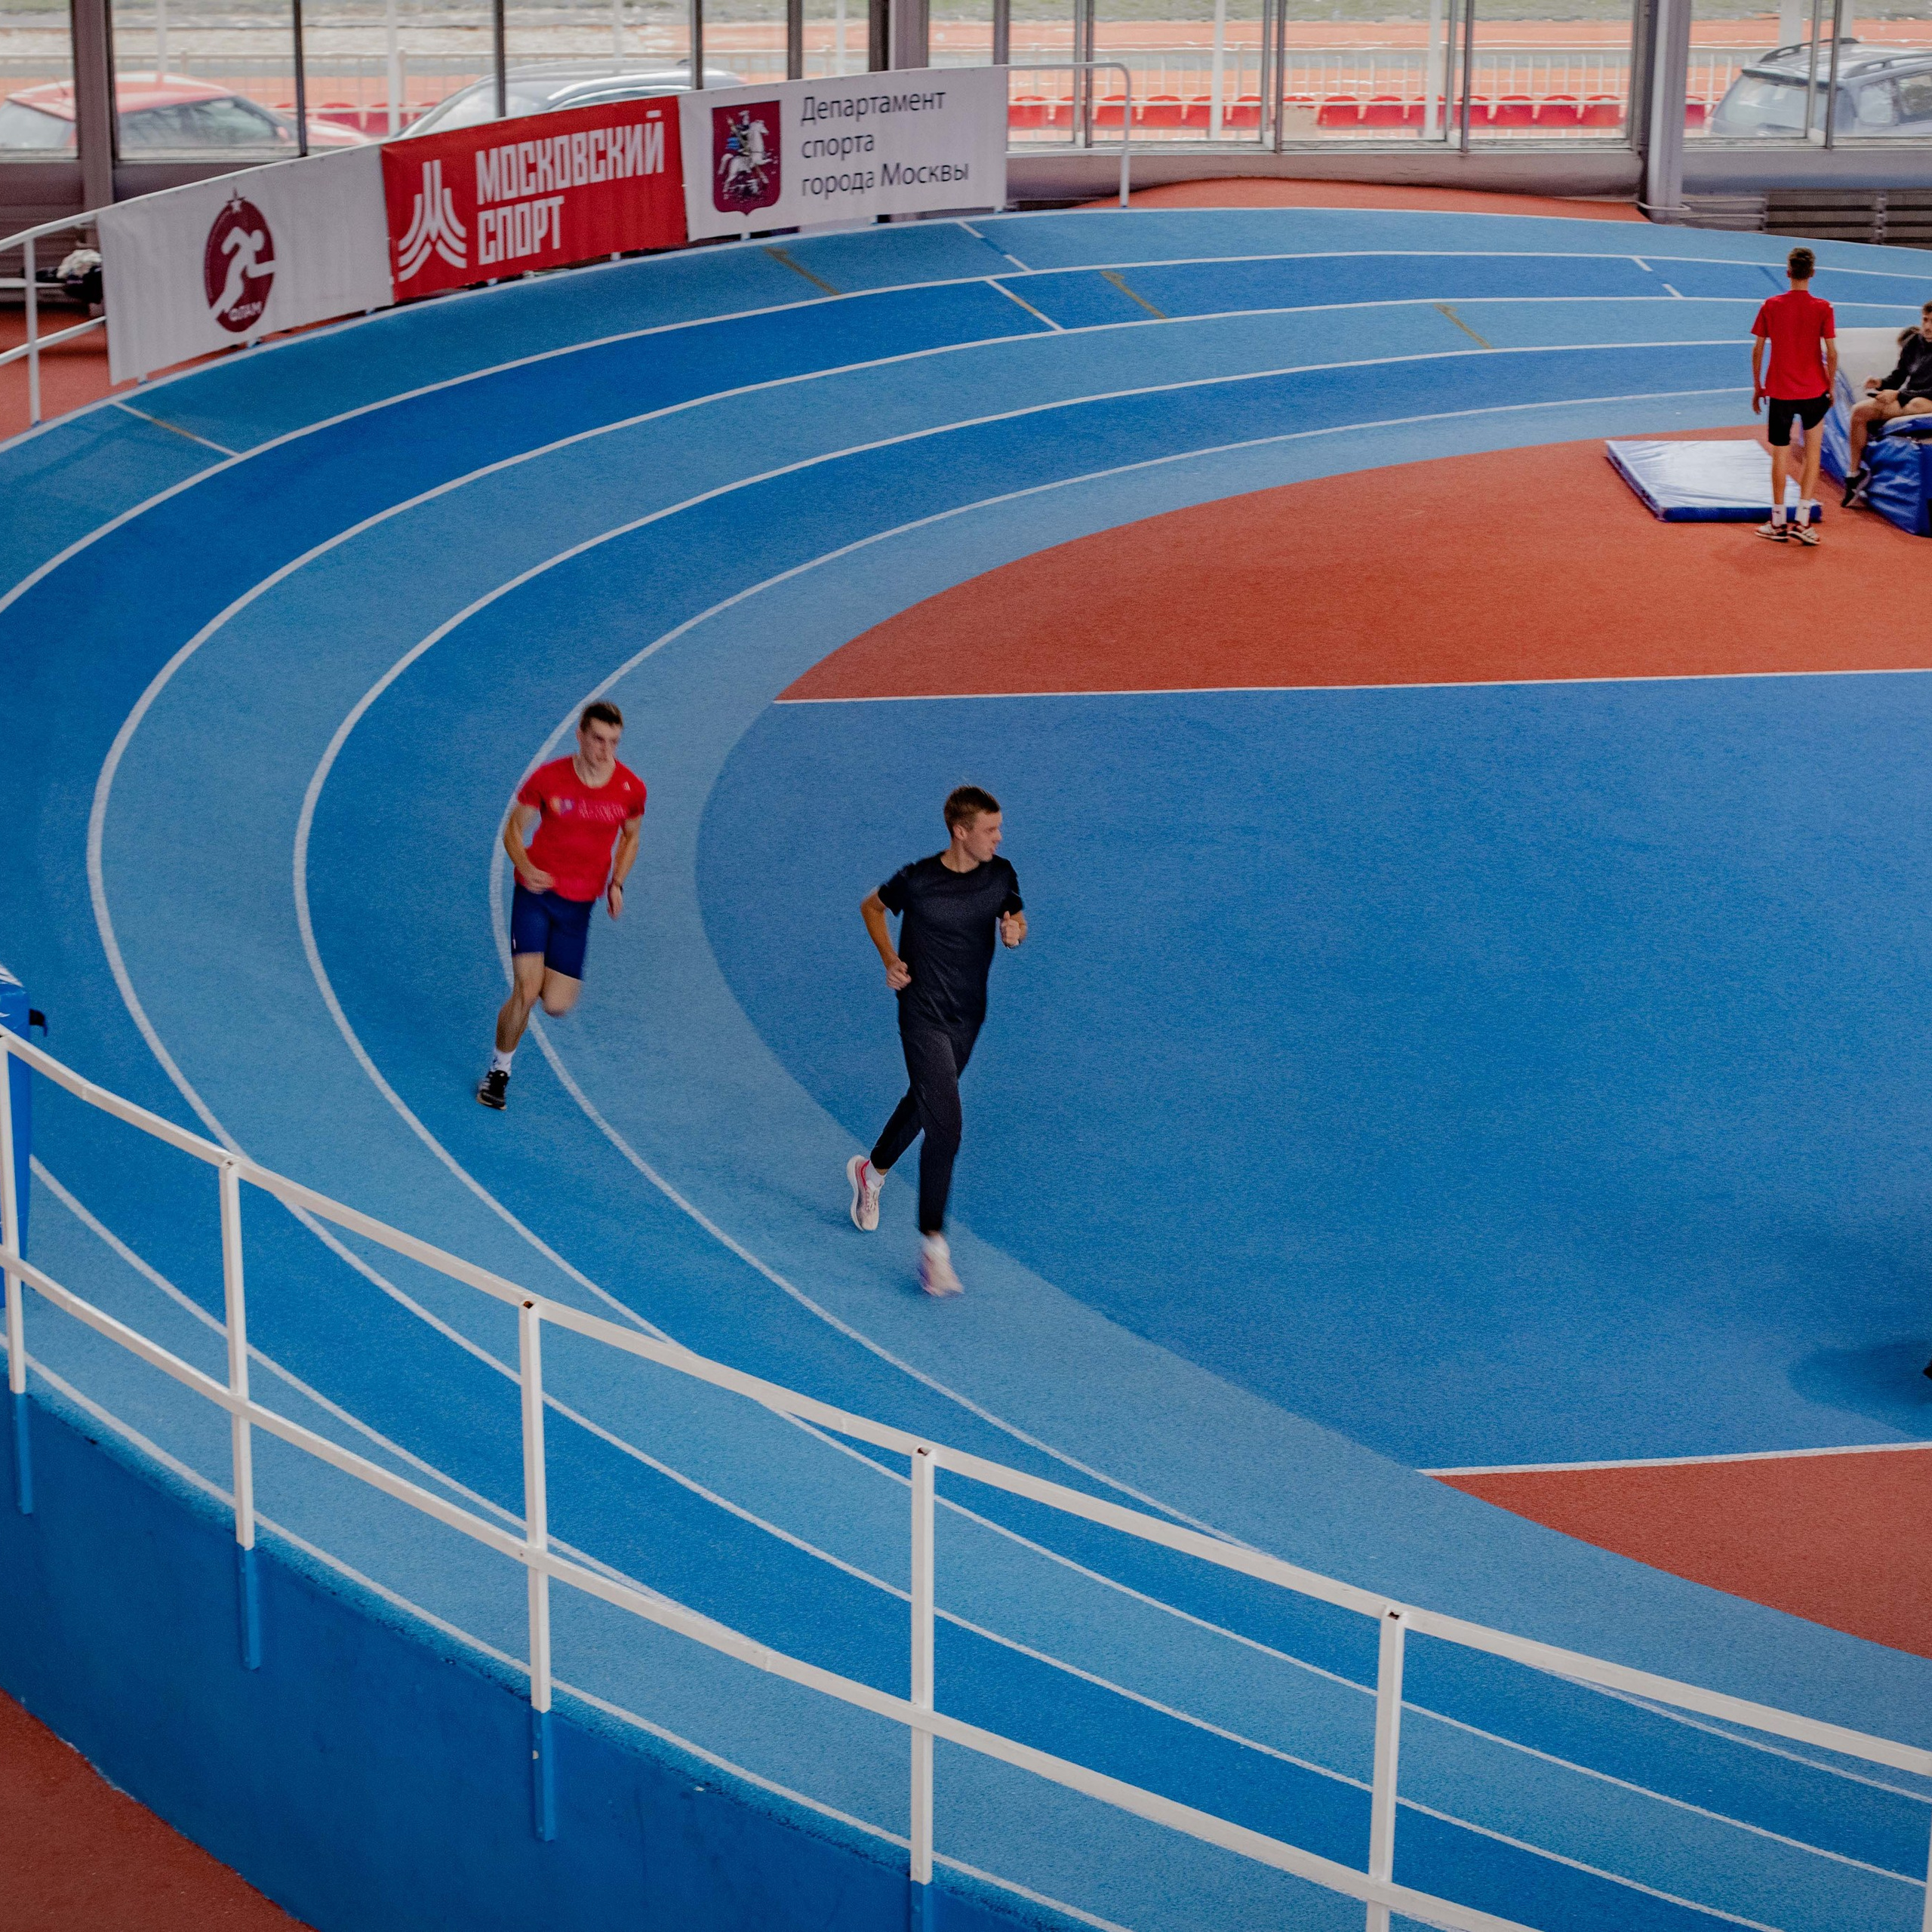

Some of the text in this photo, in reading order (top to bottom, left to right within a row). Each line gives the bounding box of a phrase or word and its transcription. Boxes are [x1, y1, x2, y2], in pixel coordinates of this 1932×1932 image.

[801, 91, 946, 126] Департамент
[475, 109, 664, 205] МОСКОВСКИЙ
[801, 134, 874, 161] спорта
[802, 162, 969, 199] города Москвы
[478, 195, 565, 266] СПОРТ
